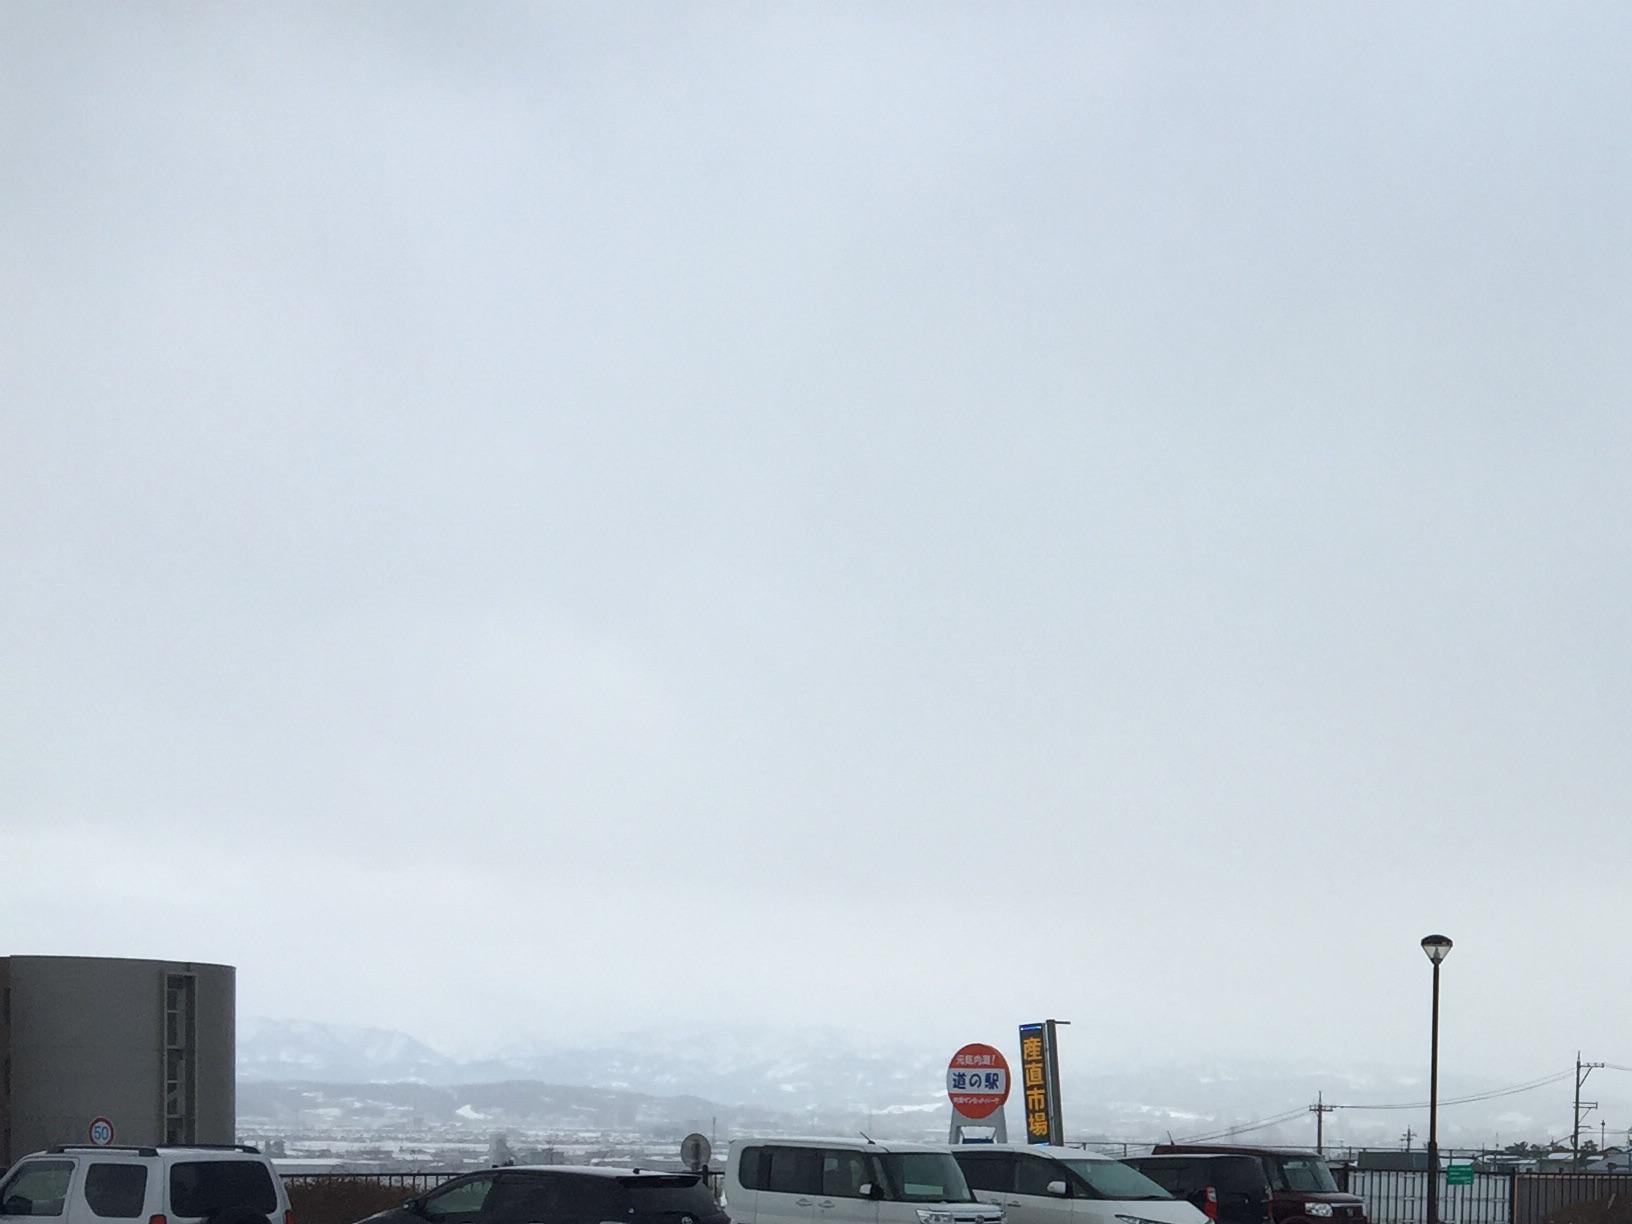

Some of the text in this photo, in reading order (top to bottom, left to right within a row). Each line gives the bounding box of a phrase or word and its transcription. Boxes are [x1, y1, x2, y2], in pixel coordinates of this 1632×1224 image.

[952, 1071, 999, 1090] 道の駅
[1023, 1037, 1048, 1136] 産直市場
[94, 1126, 109, 1140] 50
